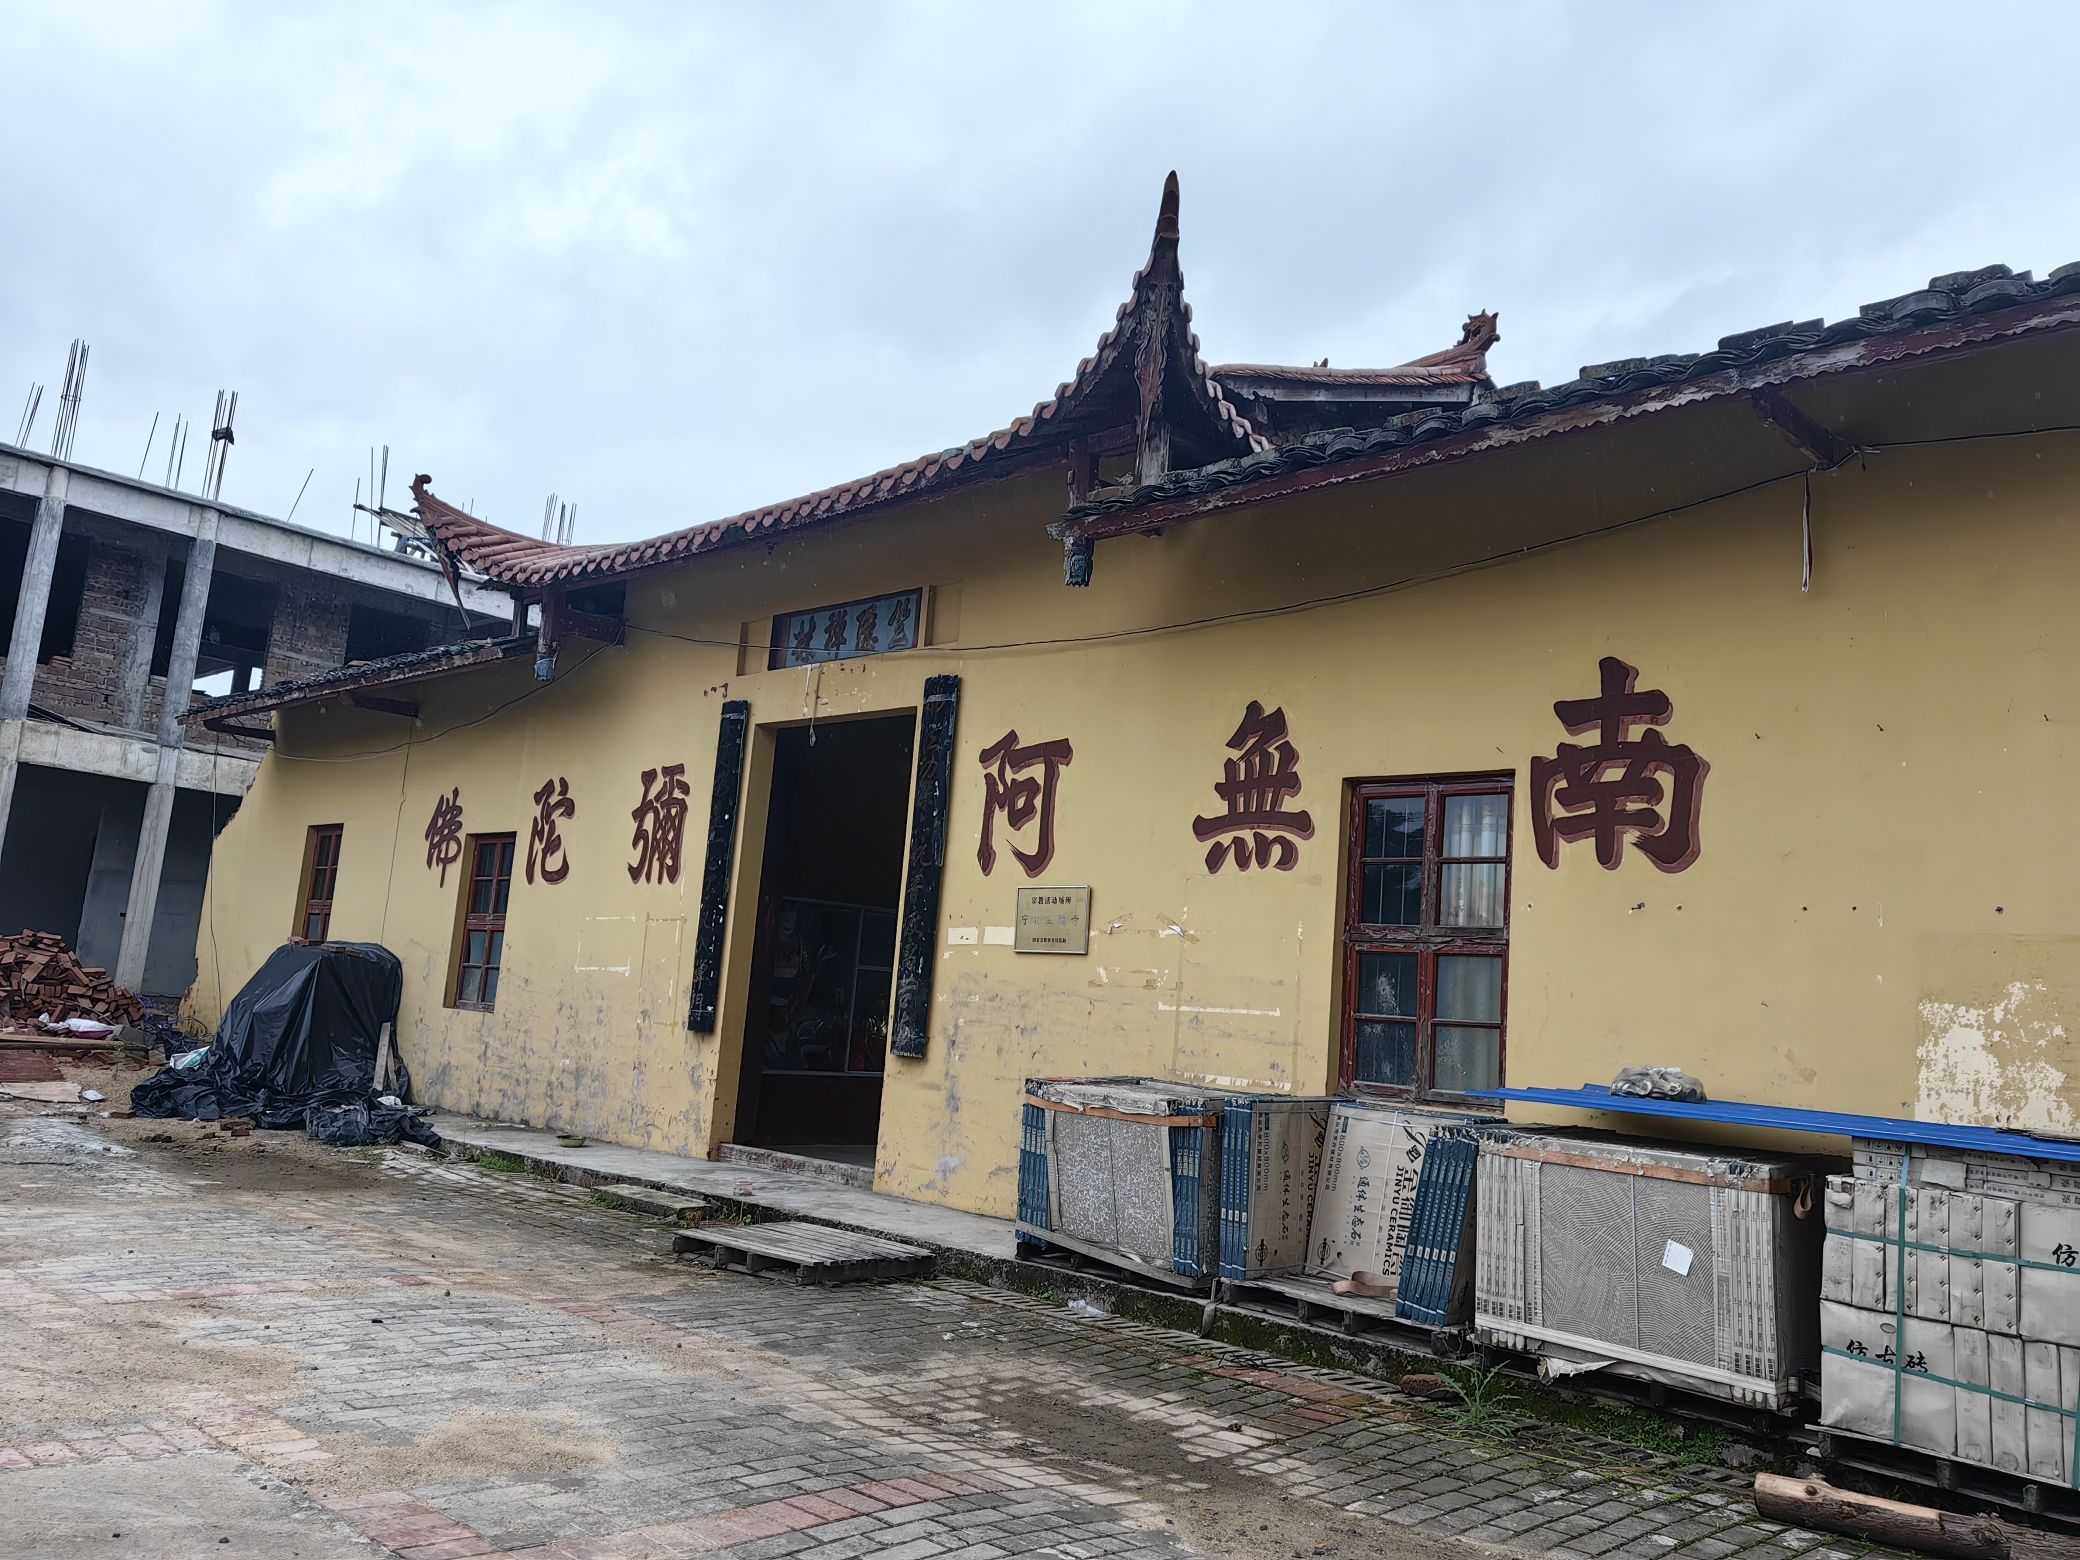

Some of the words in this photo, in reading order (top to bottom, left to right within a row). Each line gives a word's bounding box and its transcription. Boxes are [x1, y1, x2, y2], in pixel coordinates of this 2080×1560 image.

[1307, 1152, 1315, 1191] JINYU
[1391, 1164, 1405, 1206] JINYU
[1350, 1176, 1370, 1241] 通体生态石
[1381, 1207, 1400, 1277] CERAMICS
[2052, 1242, 2080, 1267] 仿
[1846, 1338, 1929, 1374] 仿古砖
